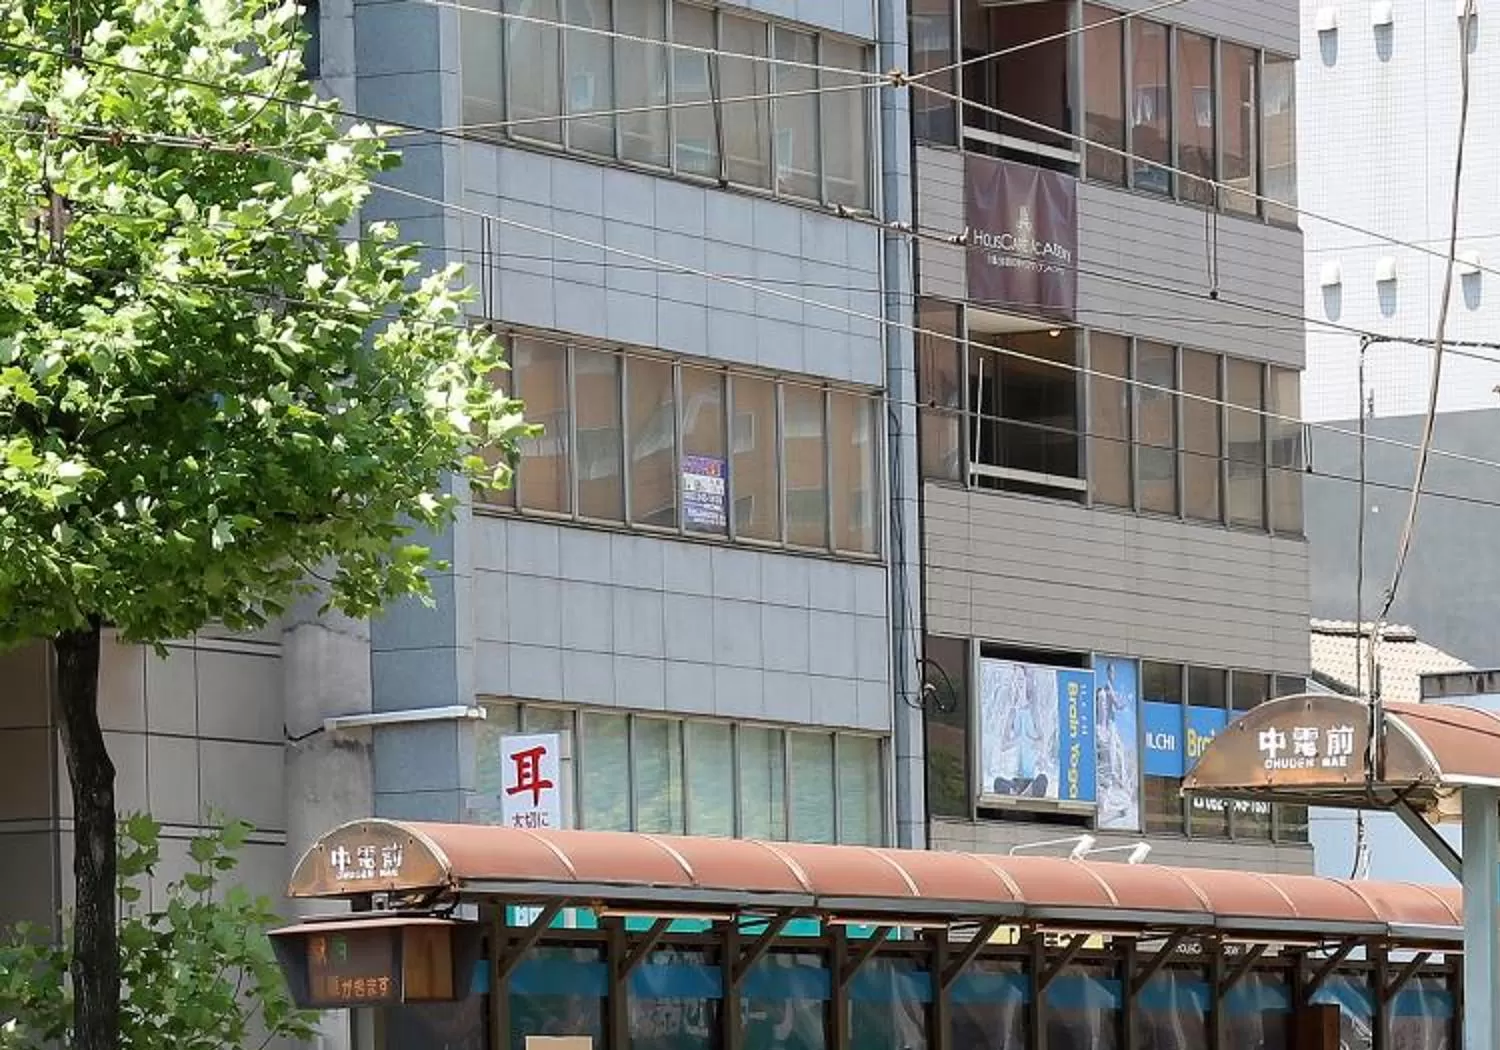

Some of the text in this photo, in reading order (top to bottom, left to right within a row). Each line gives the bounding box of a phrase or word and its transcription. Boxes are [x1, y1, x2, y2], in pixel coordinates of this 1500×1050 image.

[1145, 731, 1175, 751] ILCHI
[1259, 725, 1355, 759] 中電前
[506, 746, 553, 807] 耳
[511, 811, 549, 829] 大切に
[331, 842, 403, 873] 中電前
